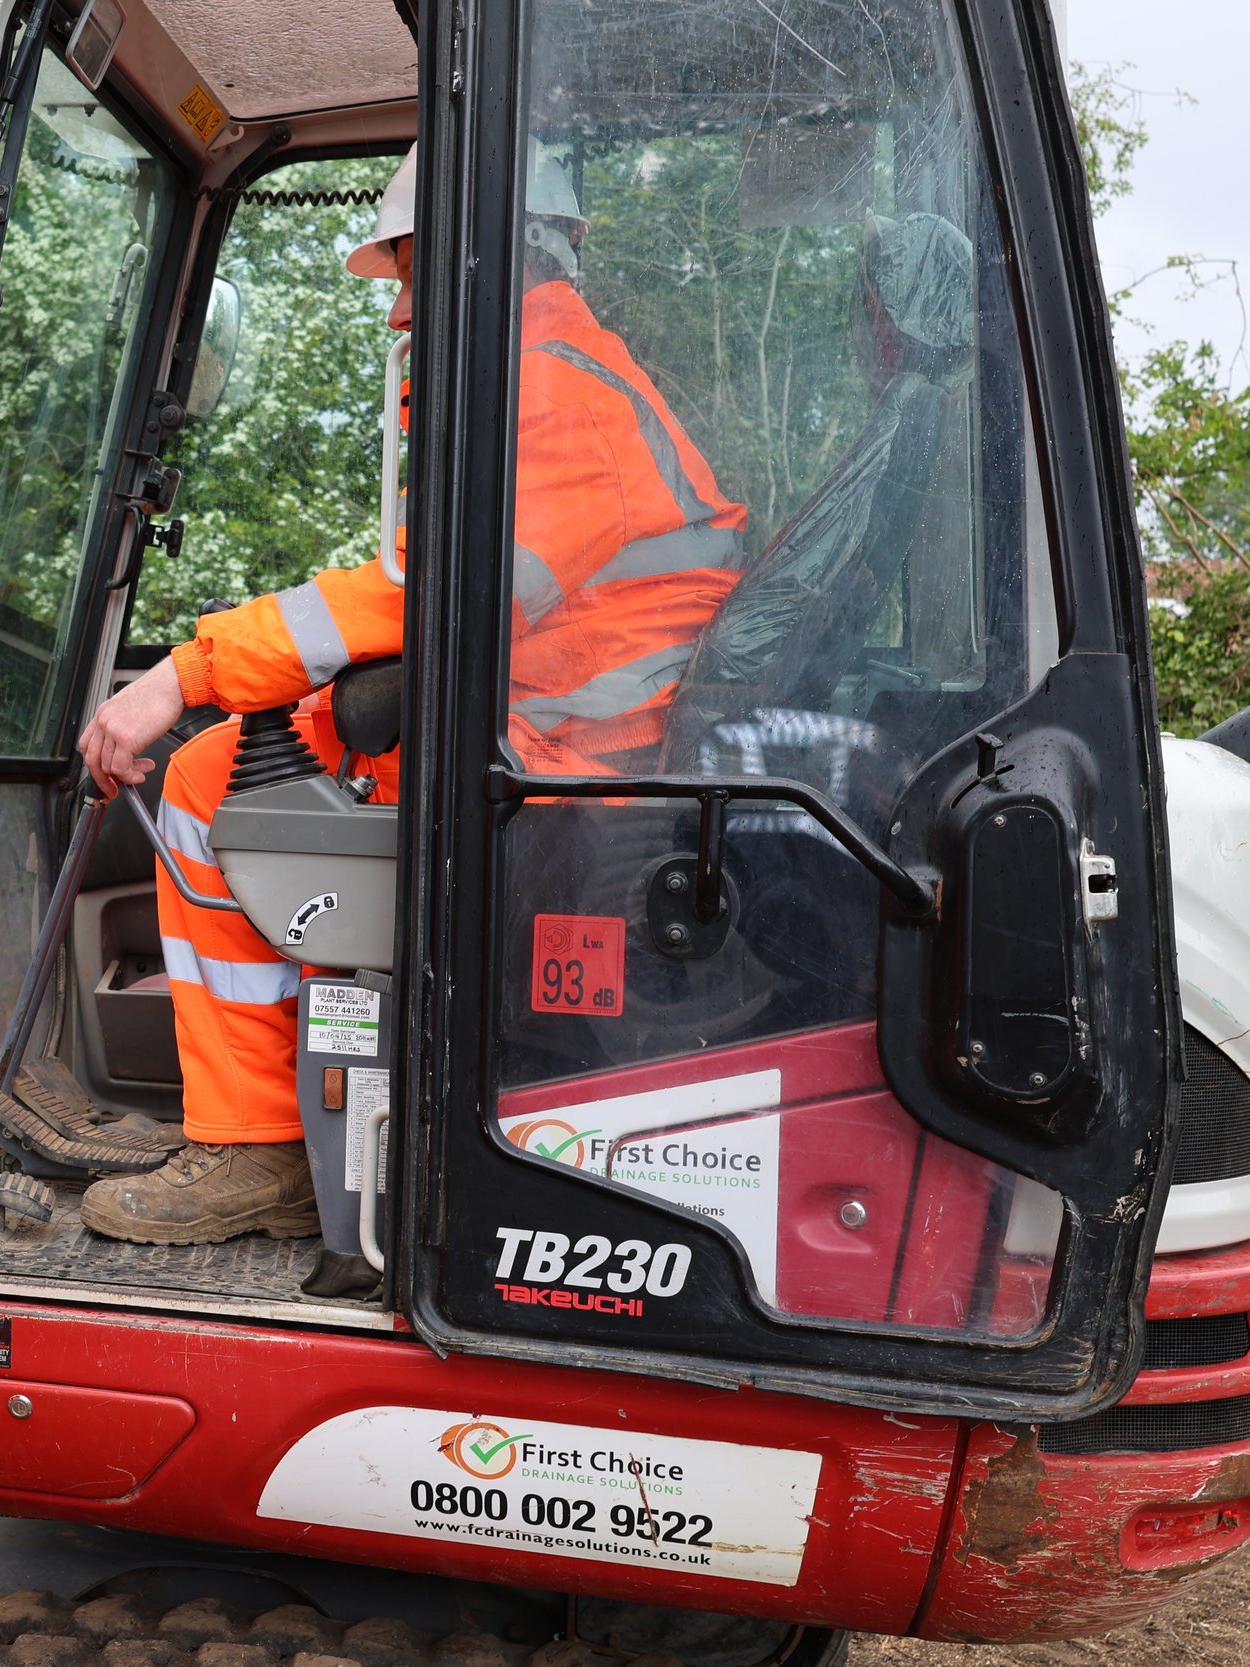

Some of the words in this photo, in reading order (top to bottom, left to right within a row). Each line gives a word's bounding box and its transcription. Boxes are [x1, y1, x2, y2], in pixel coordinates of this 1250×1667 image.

[315, 987, 375, 1002] MADDEN
[542, 958, 585, 1006] 93
[593, 987, 615, 1007] dB
[314, 1004, 339, 1013] 07557
[341, 1006, 371, 1016] 441260
[326, 1020, 361, 1028] SERVICE
[662, 1143, 762, 1173] Choice
[589, 1167, 667, 1183] DRAINAGE
[671, 1173, 762, 1190] SOLUTIONS
[494, 1227, 693, 1298] TB230
[494, 1283, 644, 1318] TAKEUCHI
[522, 1442, 583, 1469] First
[590, 1451, 684, 1481] Choice
[521, 1468, 595, 1486] DRAINAGE
[599, 1477, 684, 1497] SOLUTIONS
[410, 1479, 508, 1522] 0800
[521, 1493, 596, 1533] 002
[610, 1503, 714, 1548] 9522
[414, 1518, 711, 1567] www.fcdrainagesolutions.co.uk
